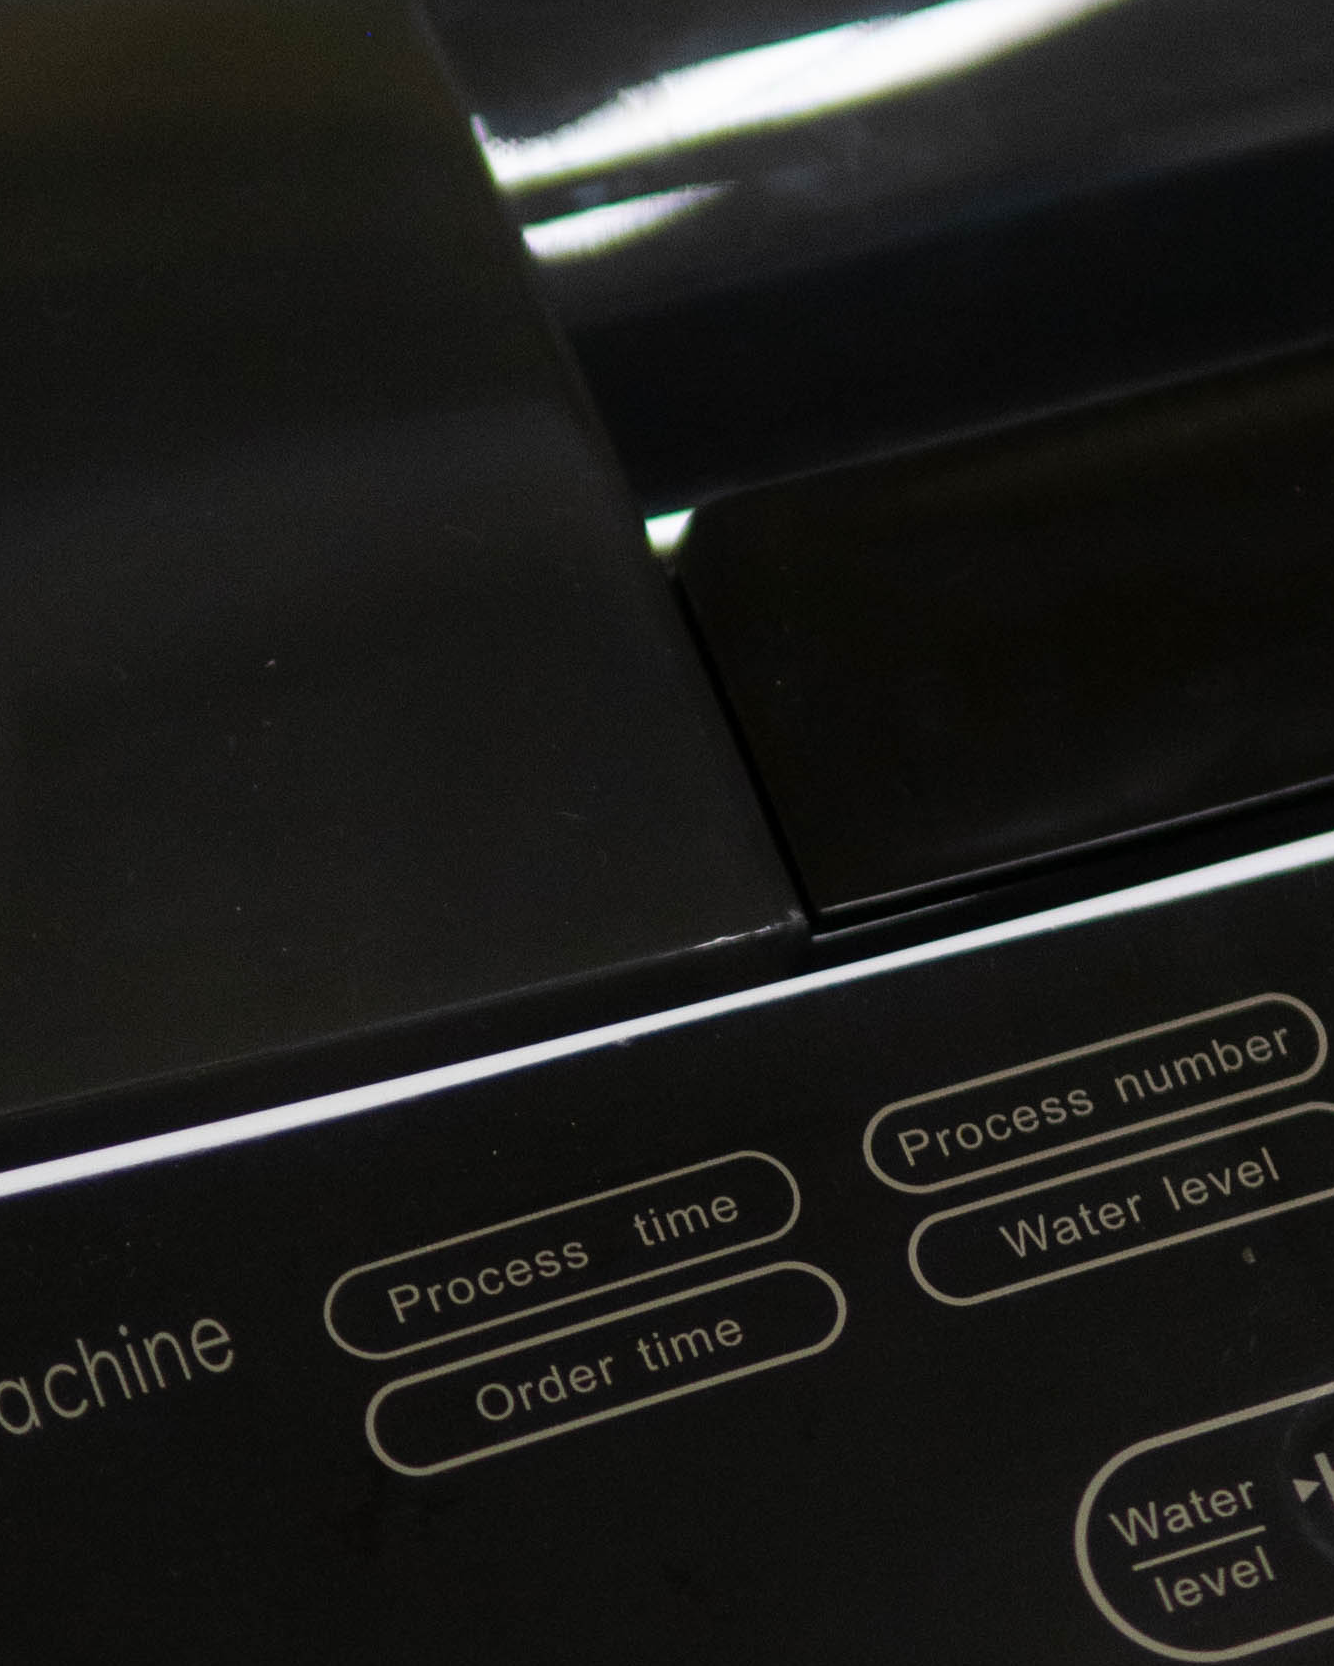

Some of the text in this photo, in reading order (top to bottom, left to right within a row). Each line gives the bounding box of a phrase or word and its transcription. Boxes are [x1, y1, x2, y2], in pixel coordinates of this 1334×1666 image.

[897, 1021, 1291, 1168] Process number
[388, 1188, 739, 1324] Process time
[998, 1146, 1282, 1260] Water level
[474, 1312, 744, 1423] Order time
[1110, 1475, 1258, 1548] Water
[1154, 1544, 1276, 1614] level
